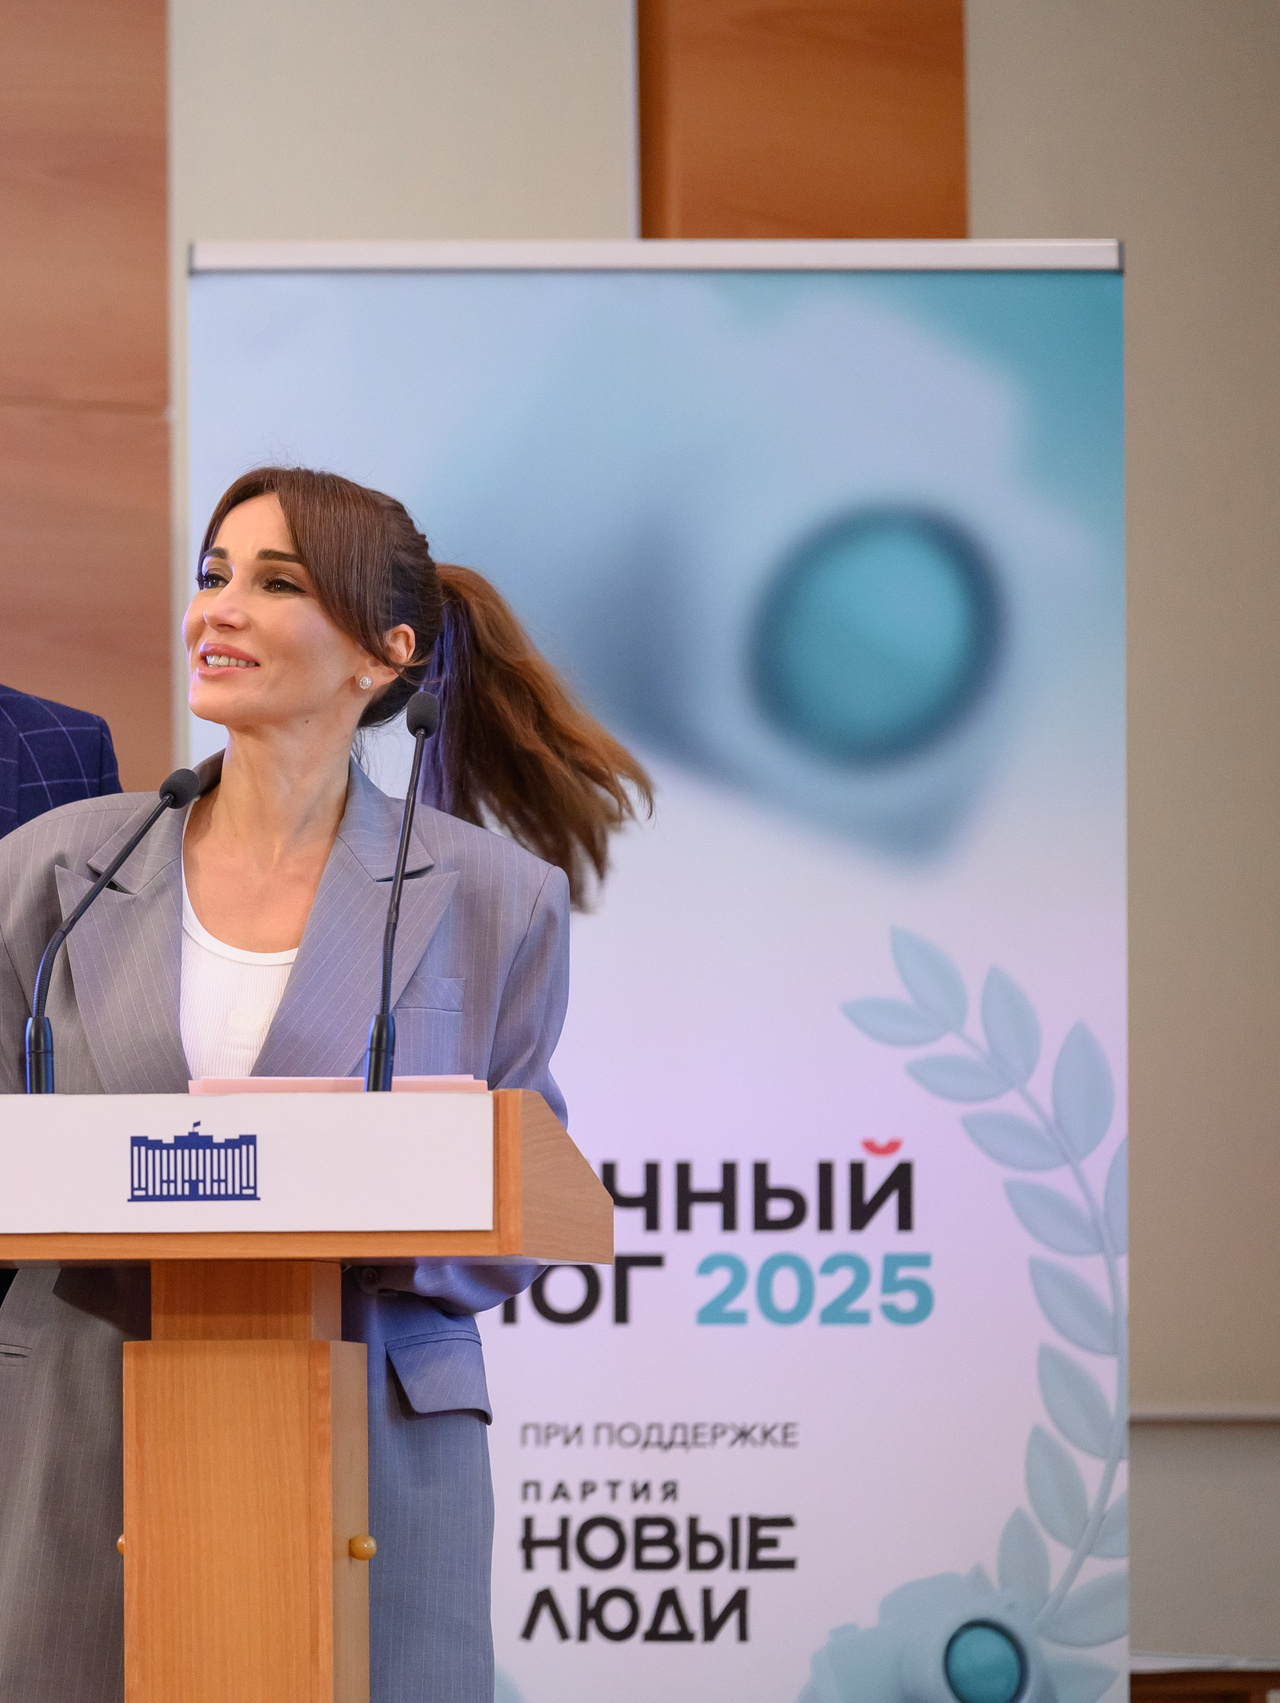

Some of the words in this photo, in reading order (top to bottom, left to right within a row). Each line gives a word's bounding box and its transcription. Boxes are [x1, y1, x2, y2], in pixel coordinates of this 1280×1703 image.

[601, 1139, 913, 1232] ЧНЫЙ
[501, 1255, 666, 1326] ОГ
[695, 1252, 936, 1327] 2025
[520, 1422, 584, 1448] ПРИ
[593, 1422, 800, 1450] ПОДДЕРЖКЕ
[521, 1480, 680, 1503] ПАРТИЯ
[520, 1516, 798, 1572] НОВЫЕ
[520, 1586, 751, 1644] ЛЮДИ
